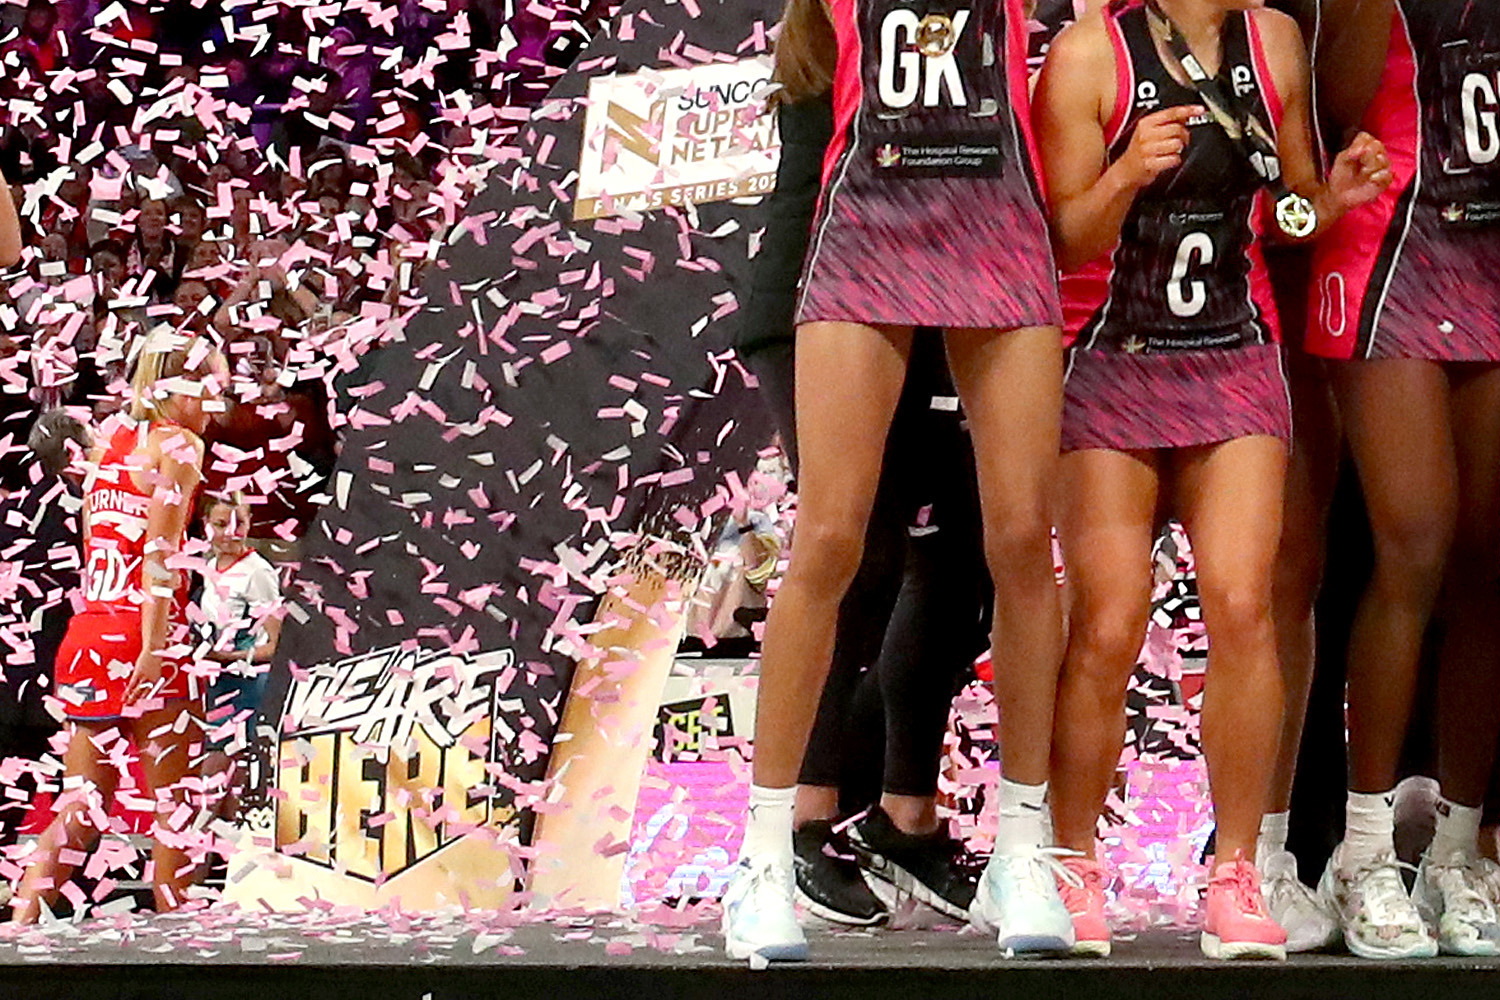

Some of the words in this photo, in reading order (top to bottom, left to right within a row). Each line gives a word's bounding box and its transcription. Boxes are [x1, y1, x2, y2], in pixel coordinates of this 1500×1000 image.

[879, 8, 971, 107] GK
[1166, 231, 1214, 318] C
[290, 655, 393, 733] WE
[351, 650, 502, 763] ARE
[275, 718, 490, 879] HERE
